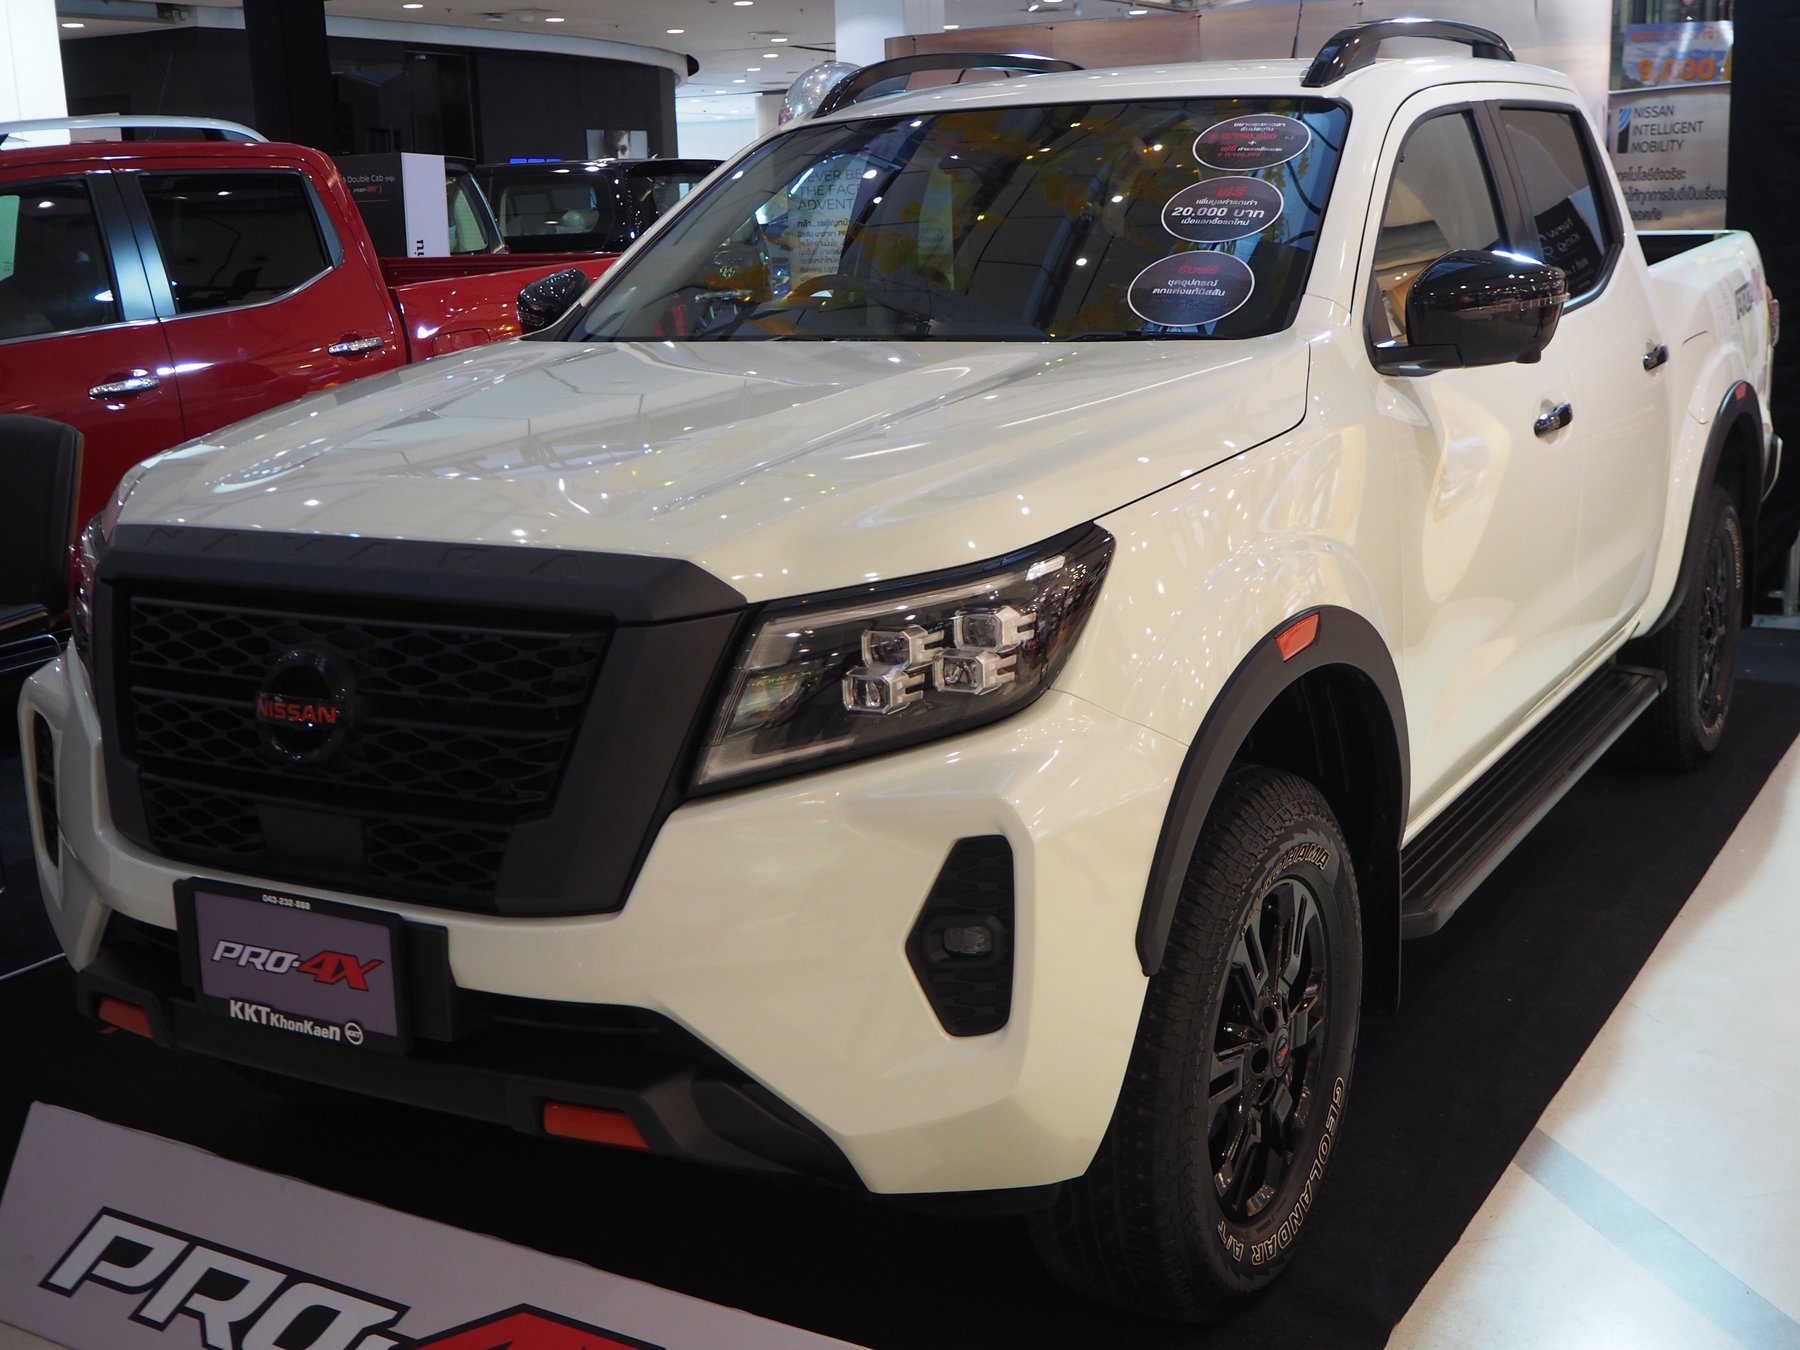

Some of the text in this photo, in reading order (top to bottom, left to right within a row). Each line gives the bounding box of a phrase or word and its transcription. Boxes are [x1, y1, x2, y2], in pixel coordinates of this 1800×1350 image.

[1634, 105, 1674, 118] NISSAN
[1632, 120, 1704, 136] INTELLIGENT
[1631, 139, 1683, 153] MOBILITY
[347, 175, 370, 184] Double
[370, 174, 384, 183] Cab
[804, 169, 842, 182] EVER
[800, 184, 825, 196] THE
[1216, 186, 1246, 197] ฟรี
[1234, 209, 1265, 218] บาท
[1168, 278, 1219, 287] ชุดอุปกรณ์
[256, 698, 337, 724] NISSAN
[211, 938, 384, 993] PRO-4X
[1217, 1076, 1345, 1266] GEOLANDAR A/T
